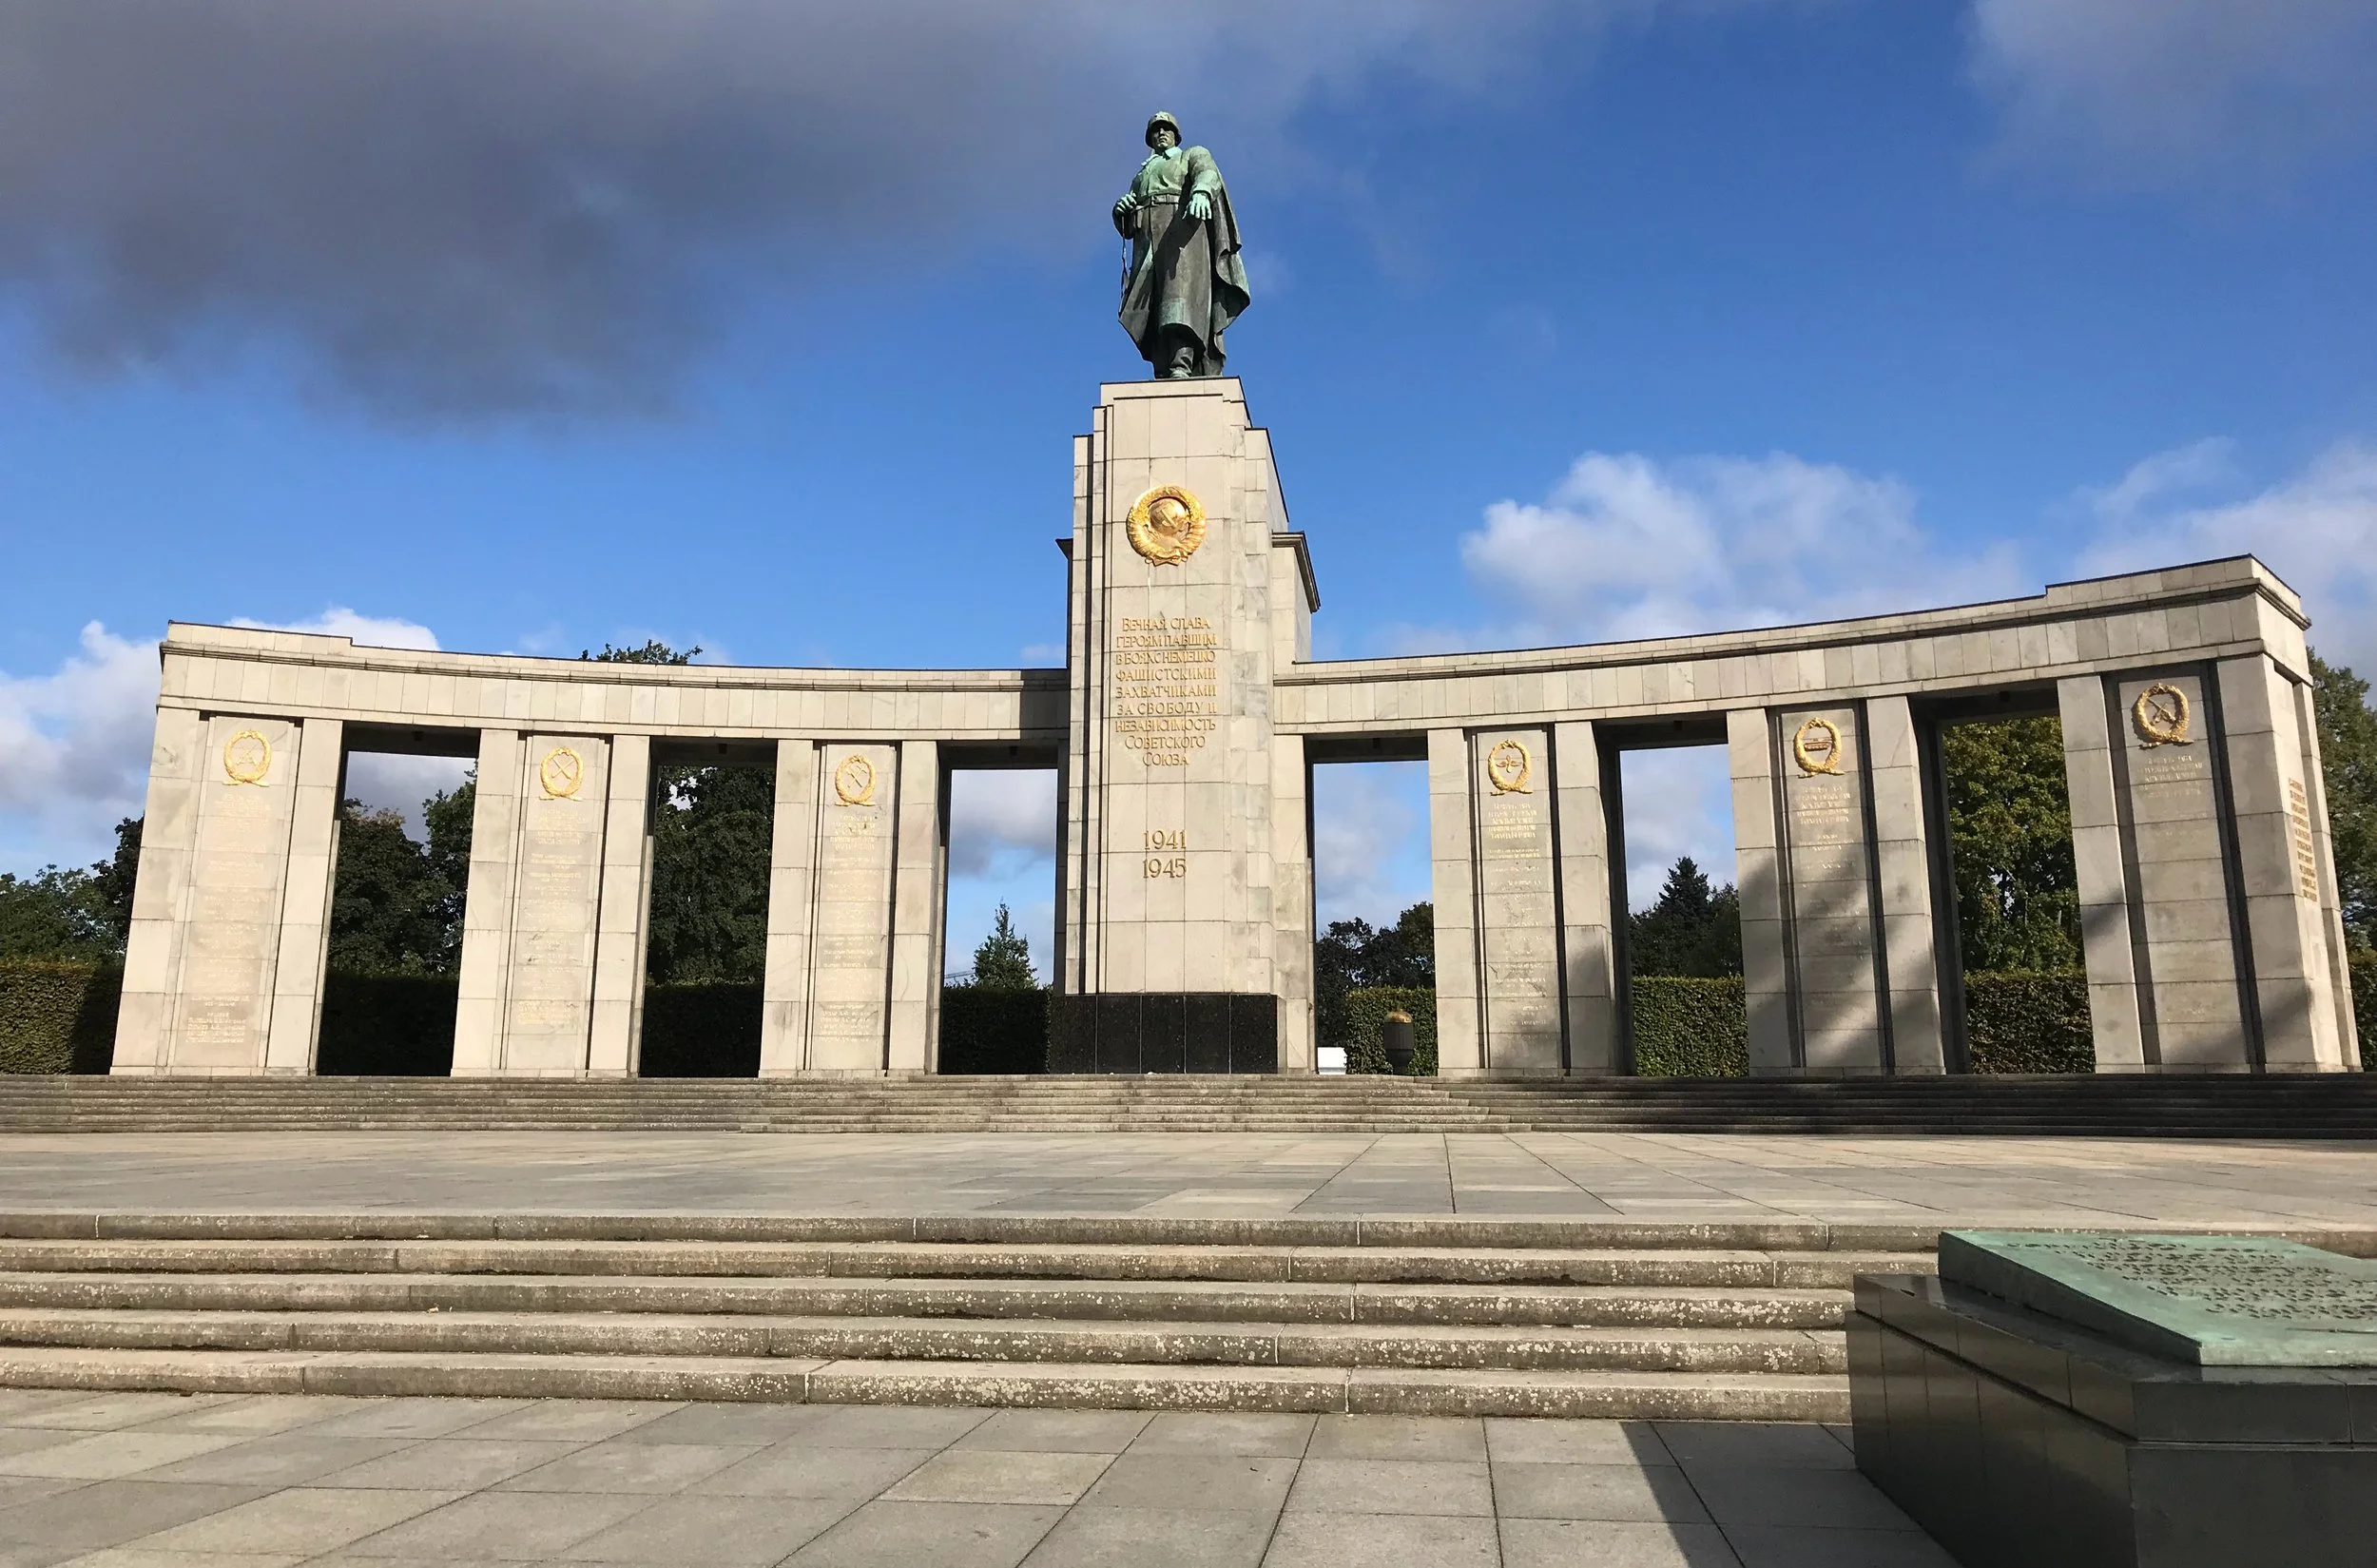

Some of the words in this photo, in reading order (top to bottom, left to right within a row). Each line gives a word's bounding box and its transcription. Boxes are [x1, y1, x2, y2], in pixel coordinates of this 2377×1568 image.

[1122, 617, 1167, 631] ВЕЧНАЯ
[1170, 617, 1210, 630] СЛАВА
[1116, 635, 1163, 648] ГЕРОЯМ
[1164, 633, 1216, 647] ПАВШИМ
[1116, 668, 1216, 682] ФАШИСТСКИМИ
[1115, 685, 1216, 699] ЗАХВАТЧИКАМИ
[1117, 704, 1133, 715] ЗА
[1137, 702, 1203, 715] СВОБОДУ
[1115, 718, 1216, 732] НЕЗАВИСИМОСТЬ
[1125, 735, 1206, 749] СОВЕТСКОГО
[1143, 751, 1189, 766] СОЮЗА
[1143, 829, 1187, 850] 1941
[1142, 858, 1187, 879] 1945
